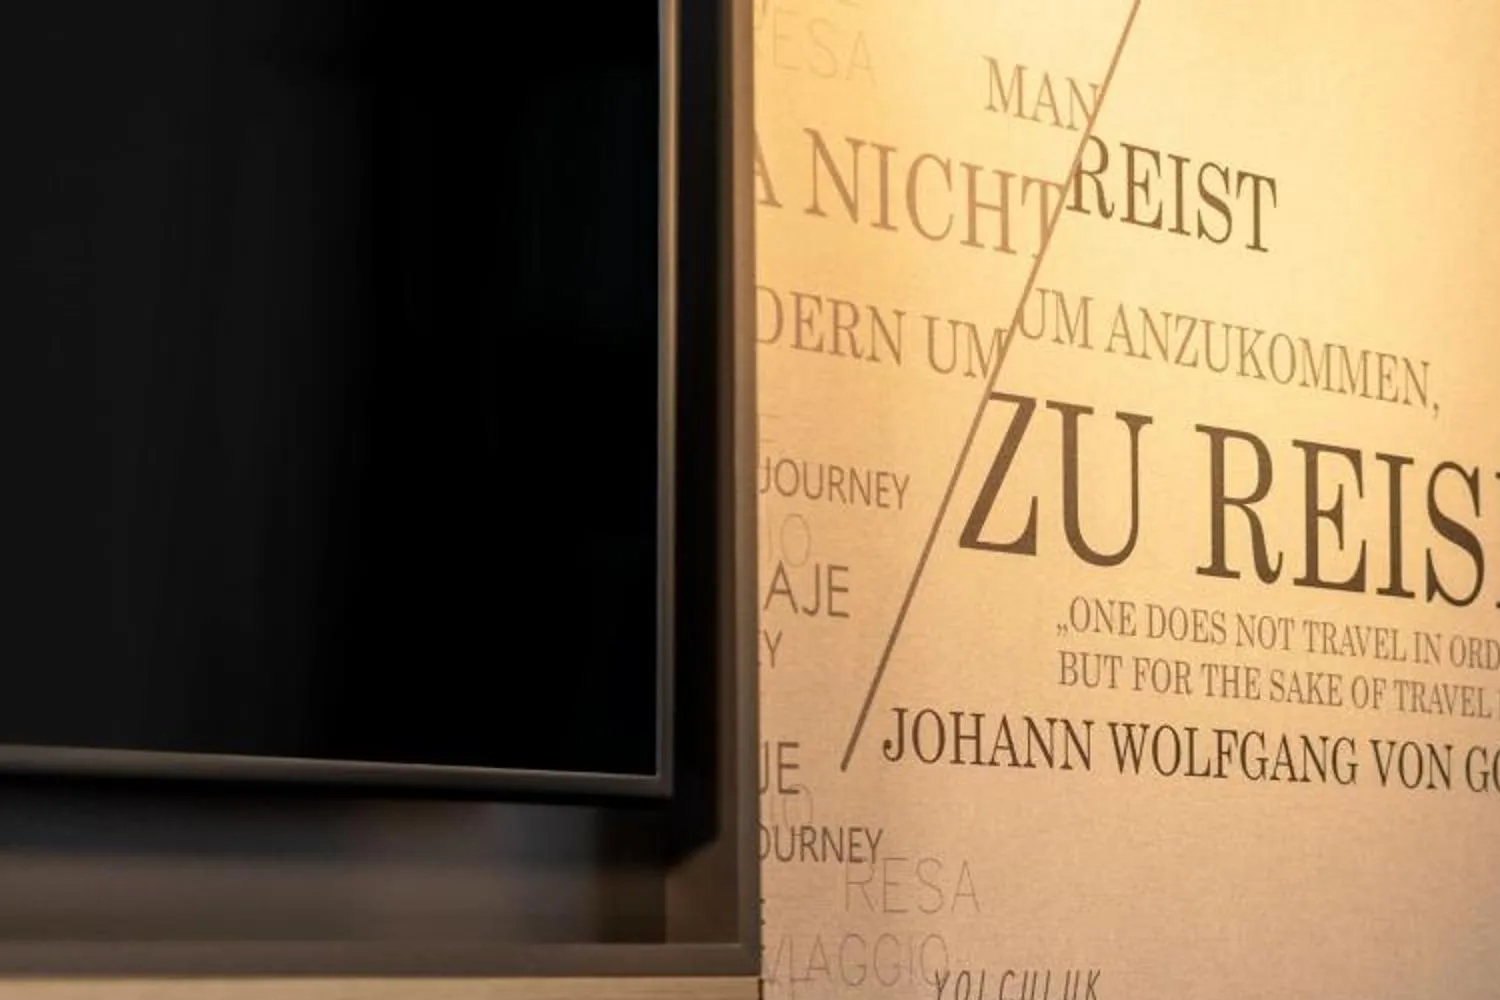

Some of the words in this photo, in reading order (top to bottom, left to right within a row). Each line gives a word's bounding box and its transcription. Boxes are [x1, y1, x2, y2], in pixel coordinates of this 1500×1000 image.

[981, 55, 1101, 131] MAN
[803, 127, 1067, 260] NICHT
[1065, 134, 1277, 253] REIST
[922, 313, 1008, 380] UM
[1018, 287, 1095, 350] UM
[1105, 302, 1440, 418] ANZUKOMMEN,
[759, 456, 911, 510] JOURNEY
[958, 391, 1154, 567] ZU
[763, 560, 850, 618] AJE
[1145, 603, 1227, 645] DOES
[1235, 612, 1298, 651] NOT
[1303, 618, 1408, 663] TRAVEL
[1414, 630, 1442, 666] IN
[1057, 650, 1122, 690] BUT
[1131, 656, 1193, 696] FOR
[1201, 662, 1262, 700] THE
[1269, 668, 1344, 707] SAKE
[1351, 675, 1386, 711] OF
[1394, 678, 1493, 719] TRAVEL
[882, 706, 1094, 771] JOHANN
[1107, 721, 1360, 786] WOLFGANG
[1369, 738, 1454, 791] VON
[844, 857, 982, 914] RESA
